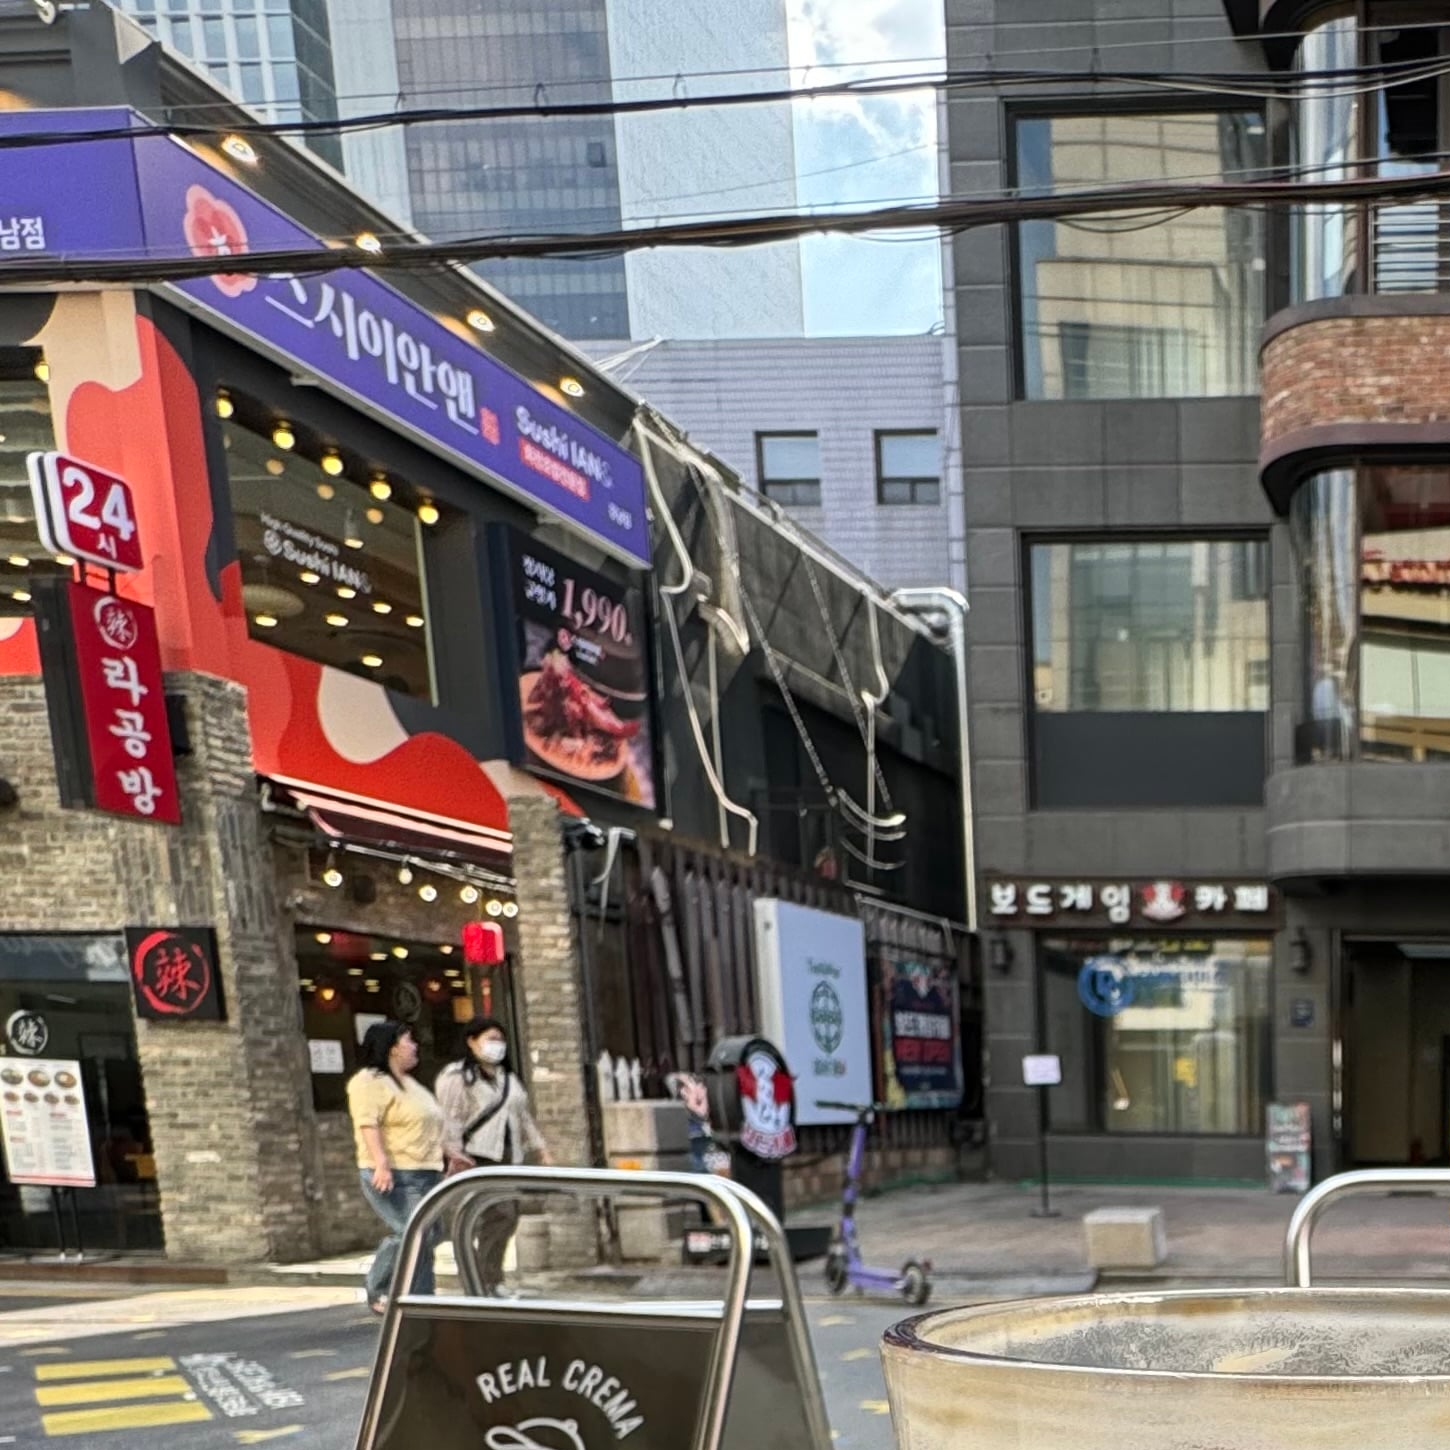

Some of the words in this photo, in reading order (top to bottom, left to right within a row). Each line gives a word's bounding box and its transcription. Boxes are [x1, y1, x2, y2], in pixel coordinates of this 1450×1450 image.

[515, 405, 569, 461] Sushi
[62, 466, 135, 542] 24
[97, 532, 117, 559] 시
[101, 656, 162, 815] 라공방
[990, 883, 1132, 924] 보드게임
[1194, 884, 1269, 912] 카페
[476, 1355, 551, 1404] REAL
[561, 1358, 645, 1440] CREMA
